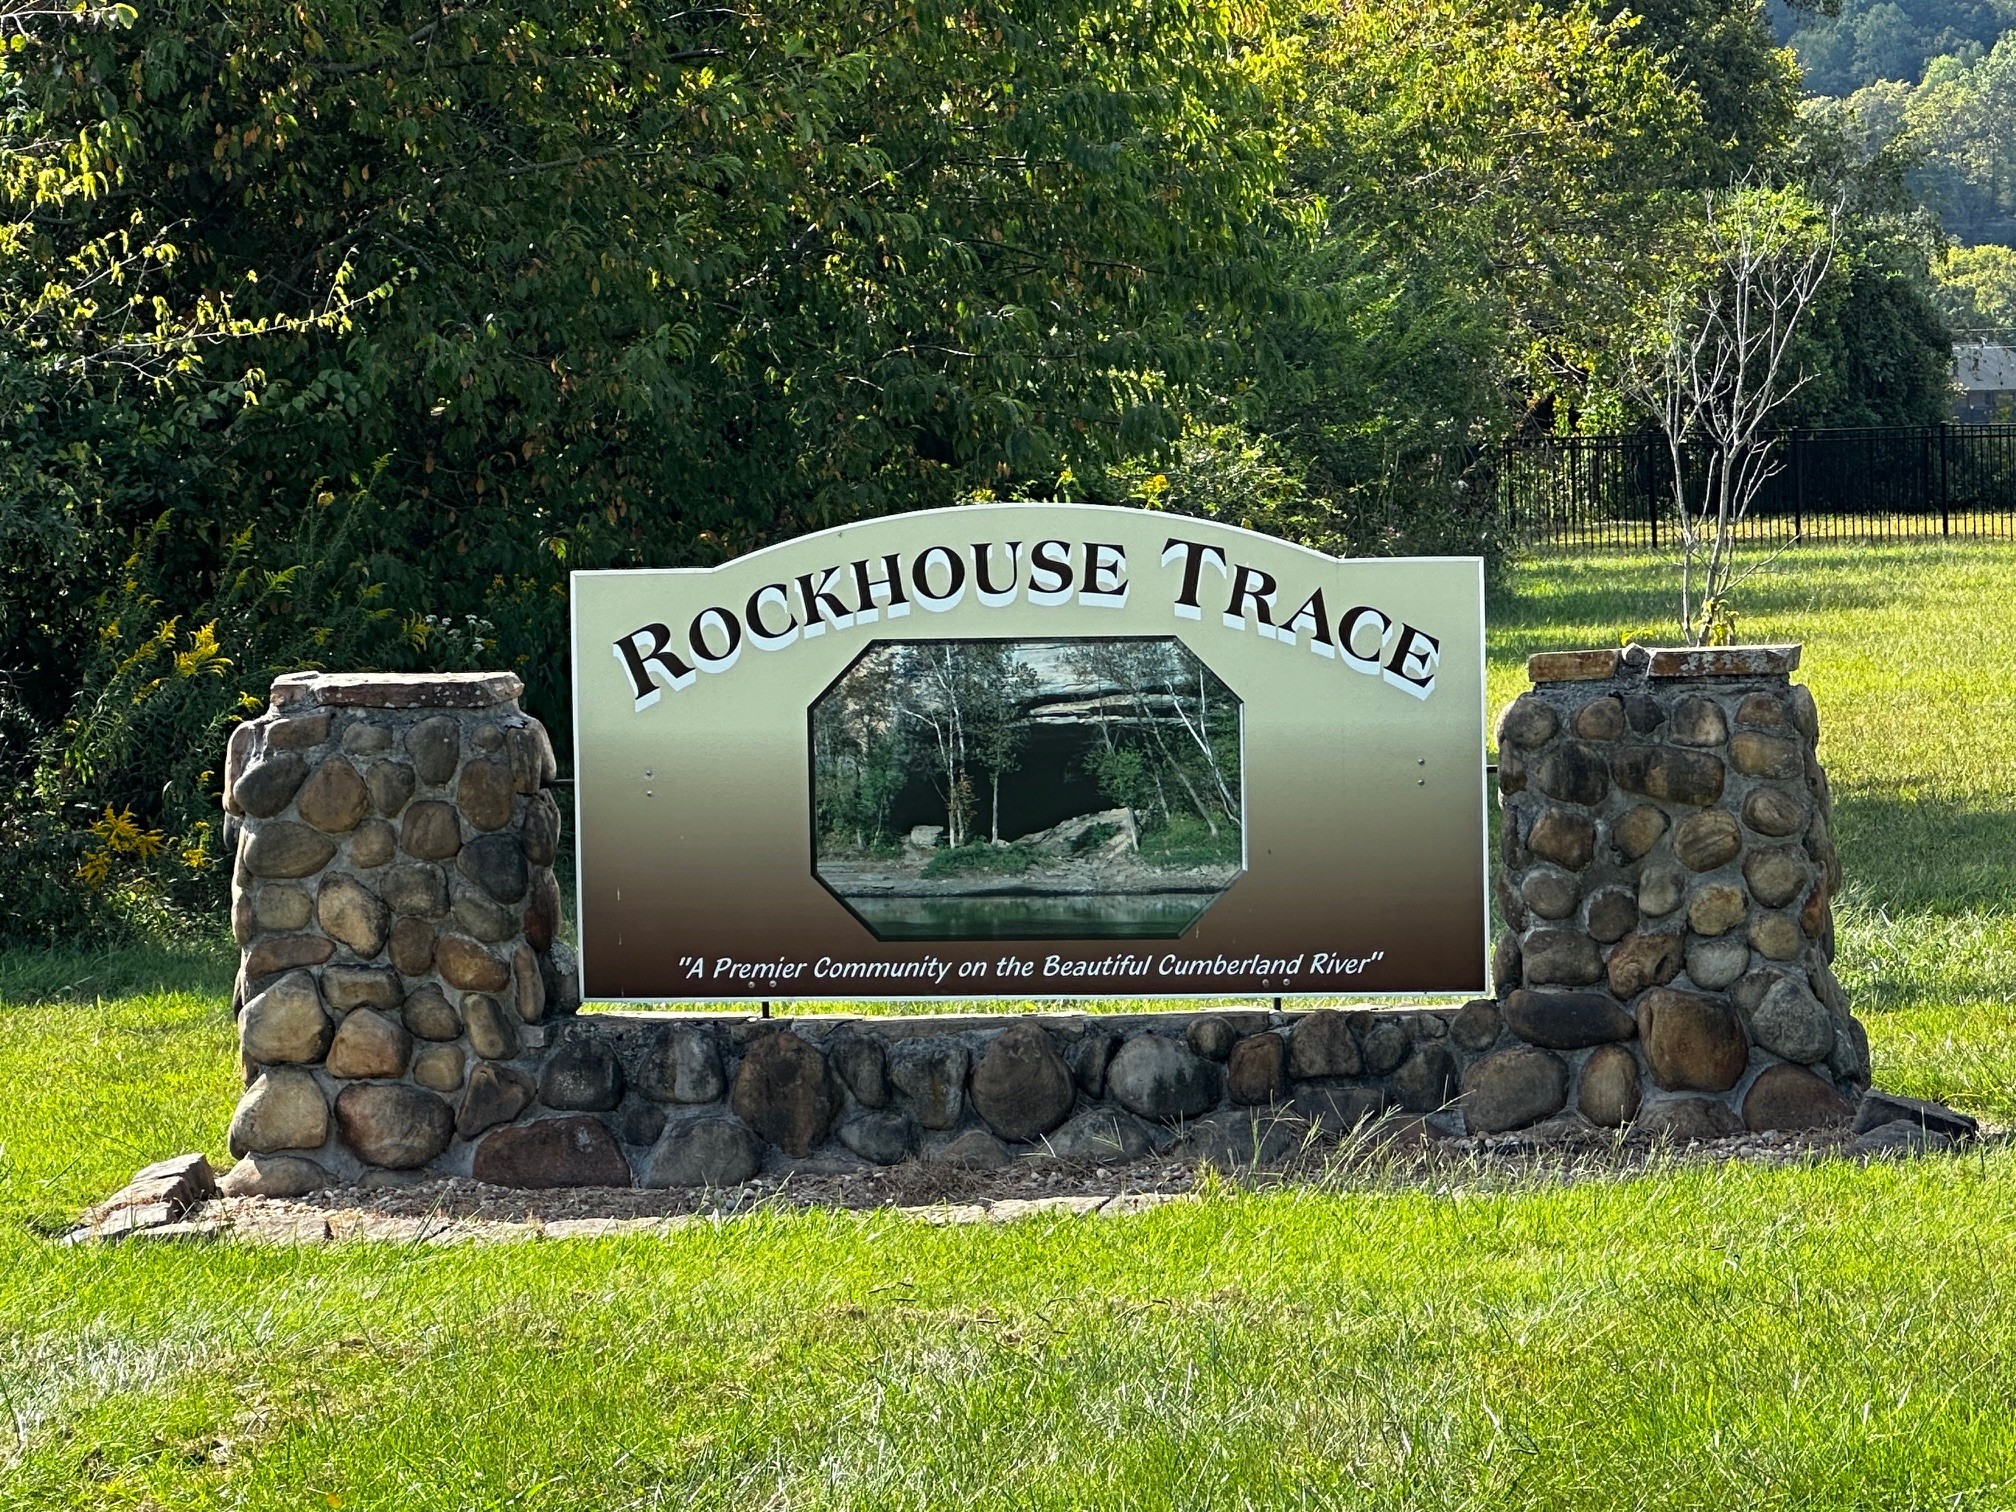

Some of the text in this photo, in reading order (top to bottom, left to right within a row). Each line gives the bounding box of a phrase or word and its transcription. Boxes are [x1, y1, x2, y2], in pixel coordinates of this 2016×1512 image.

[612, 538, 1439, 711] ROCKHOUSE TRACE
[678, 951, 1384, 984] "A Premier Community on the Beautiful Cumberland River"
